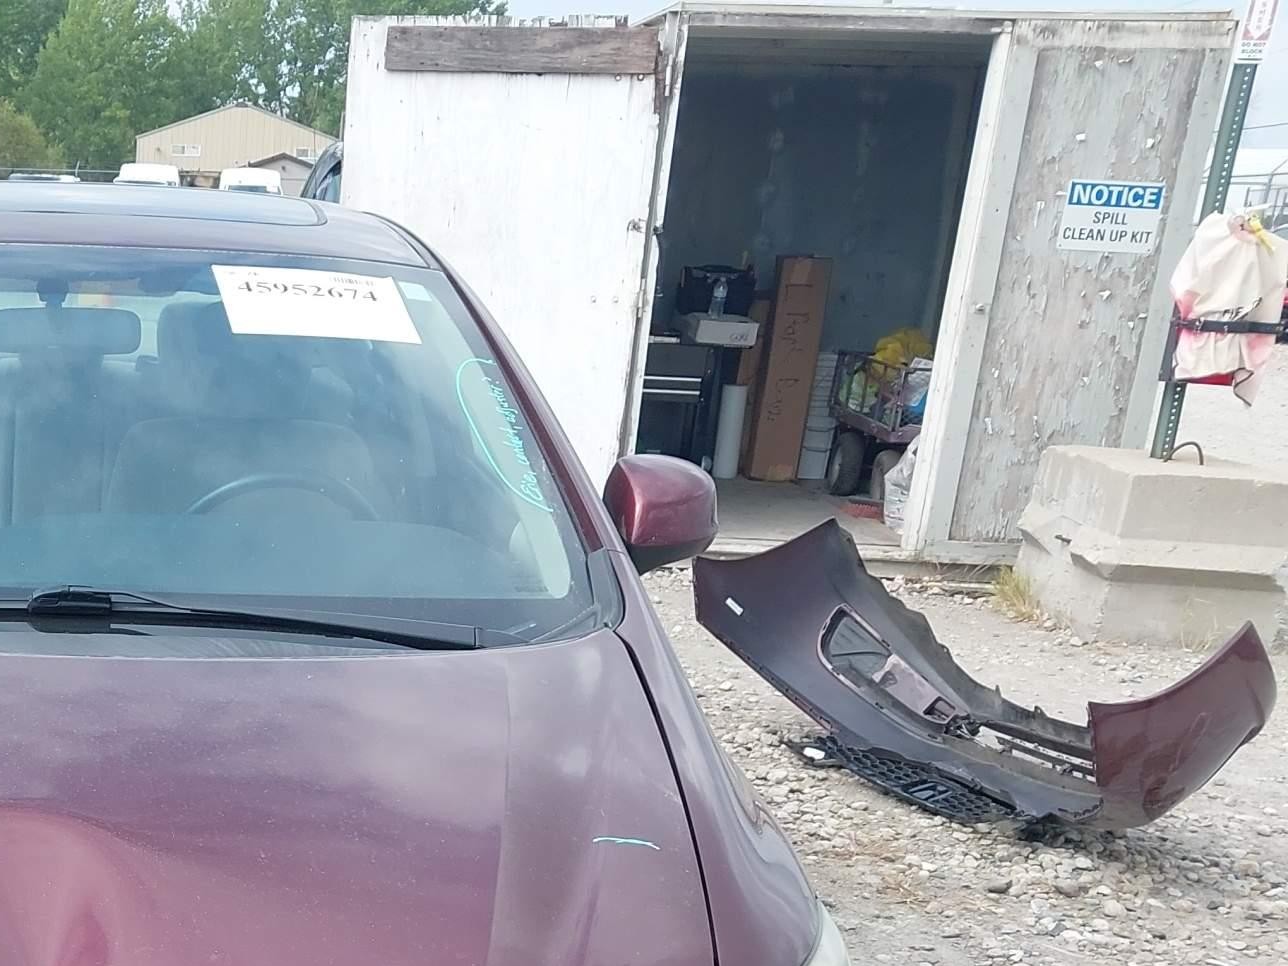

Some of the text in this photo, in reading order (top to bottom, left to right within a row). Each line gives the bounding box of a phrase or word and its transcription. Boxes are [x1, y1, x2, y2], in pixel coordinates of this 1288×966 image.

[1071, 184, 1159, 207] NOTICE
[1092, 211, 1128, 225] SPILL
[1062, 226, 1153, 244] CLEAN UP KIT
[237, 280, 378, 302] 45952674
